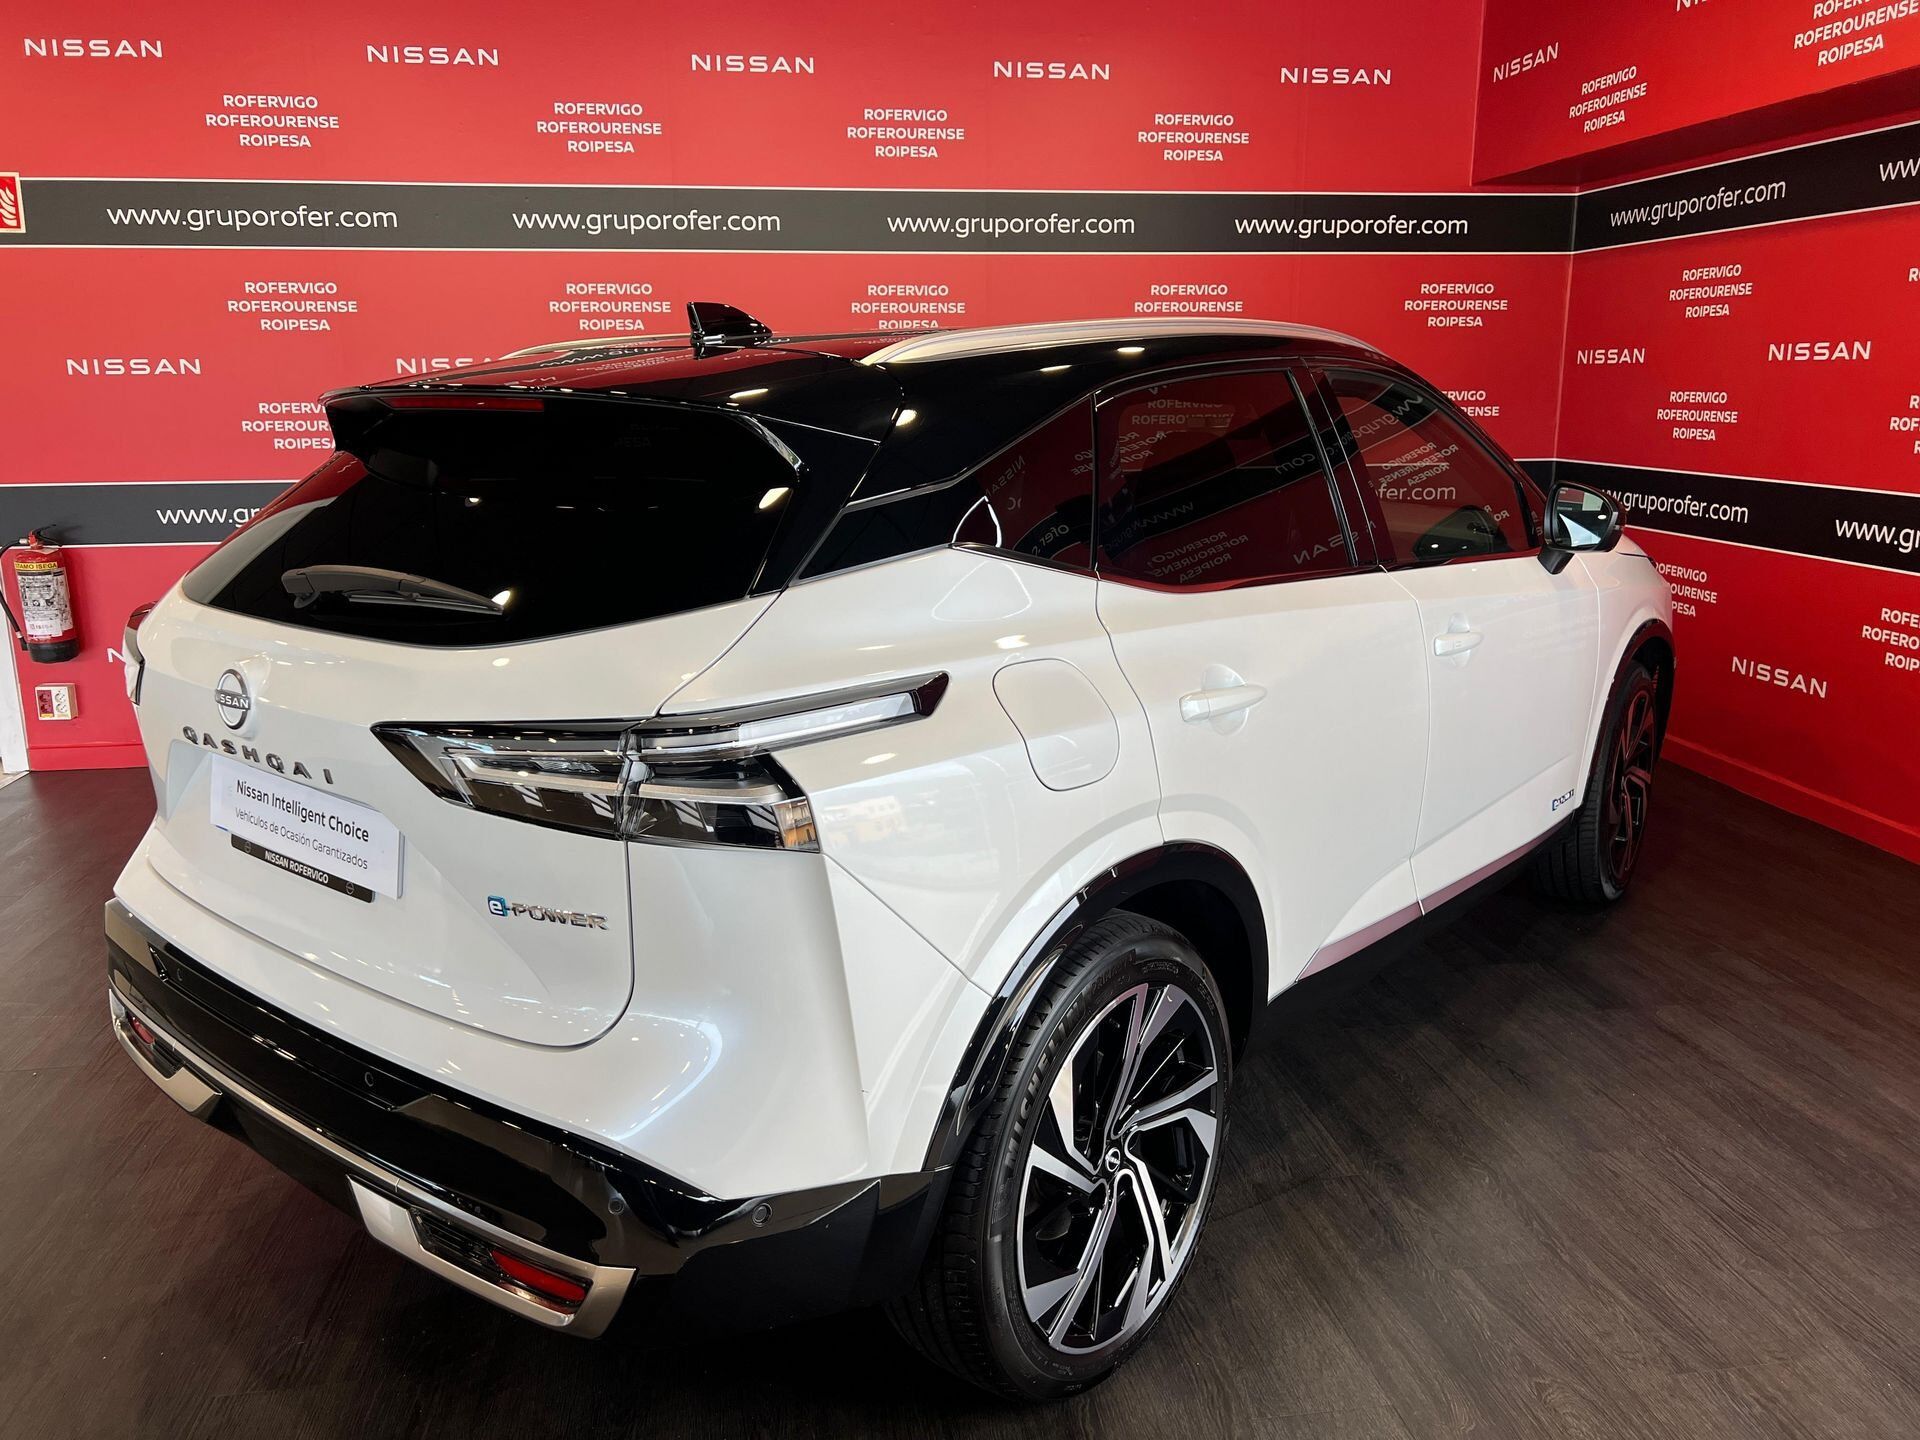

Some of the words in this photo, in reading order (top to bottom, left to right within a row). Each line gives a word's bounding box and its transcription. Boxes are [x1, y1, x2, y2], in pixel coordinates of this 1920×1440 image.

[1793, 0, 1919, 49] ROFEROURENSE
[24, 38, 163, 58] NISSAN
[366, 45, 500, 66] NISSAN
[1817, 33, 1884, 67] ROIPESA
[691, 54, 815, 74] NISSAN
[993, 61, 1111, 80] NISSAN
[1493, 43, 1559, 82] NISSAN
[1281, 67, 1392, 85] NISSAN
[1581, 66, 1637, 95] ROFERVIGO
[222, 95, 319, 109] ROFERVIGO
[1569, 83, 1647, 118] ROFEROURENSE
[553, 102, 643, 116] ROFERVIGO
[863, 108, 948, 121] ROFERVIGO
[205, 113, 340, 129] ROFEROURENSE
[1154, 113, 1234, 126] ROFERVIGO
[1583, 110, 1626, 132] ROIPESA
[536, 121, 662, 135] ROFEROURENSE
[846, 127, 965, 140] ROFEROURENSE
[239, 134, 312, 148] ROIPESA
[1138, 130, 1250, 144] ROFEROURENSE
[567, 140, 635, 154] ROIPESA
[874, 146, 938, 158] ROIPESA
[1163, 149, 1224, 162] ROIPESA
[1610, 180, 1786, 226] www.gruporofer.com
[107, 206, 398, 231] www.gruporofer.com
[512, 210, 781, 235] www.gruporofer.com
[887, 213, 1135, 238] www.gruporofer.com
[1234, 214, 1468, 238] www.gruporofer.com
[1682, 264, 1742, 281] ROFERVIGO
[244, 281, 337, 294] ROFERVIGO
[566, 284, 652, 295] ROFERVIGO
[867, 285, 949, 296] ROFERVIGO
[1150, 284, 1228, 296] ROFERVIGO
[1420, 283, 1494, 295] ROFERVIGO
[1669, 282, 1753, 301] ROFEROURENSE
[227, 300, 358, 313] ROFEROURENSE
[549, 302, 671, 314] ROFEROURENSE
[851, 302, 966, 314] ROFEROURENSE
[1134, 302, 1243, 313] ROFEROURENSE
[1404, 300, 1508, 311] ROFEROURENSE
[1685, 304, 1730, 319] ROIPESA
[260, 318, 331, 331] ROIPESA
[579, 320, 644, 331] ROIPESA
[1427, 316, 1483, 327] ROIPESA
[1577, 348, 1646, 365] NISSAN
[1768, 341, 1872, 361] NISSAN
[67, 358, 201, 376] NISSAN
[1669, 391, 1728, 404] ROFERVIGO
[1656, 409, 1738, 423] ROFEROURENSE
[1672, 428, 1716, 441] ROIPESA
[1881, 607, 1920, 629] ROFE
[1884, 652, 1920, 673] ROIP
[1732, 657, 1827, 698] NISSAN
[220, 693, 250, 709] SSAN
[182, 725, 334, 785] QASHQAI
[236, 779, 269, 805] Nissan
[271, 793, 326, 827] Intelligent
[328, 815, 369, 842] Choice
[235, 807, 268, 830] Vehículos
[269, 821, 279, 834] de
[280, 826, 310, 848] Ocasión
[311, 838, 368, 870] Garantizados
[264, 851, 289, 869] NISSAN
[289, 860, 328, 884] ROFERVIGO
[487, 895, 608, 931] e-POWER
[1006, 993, 1087, 1168] MICHELIN
